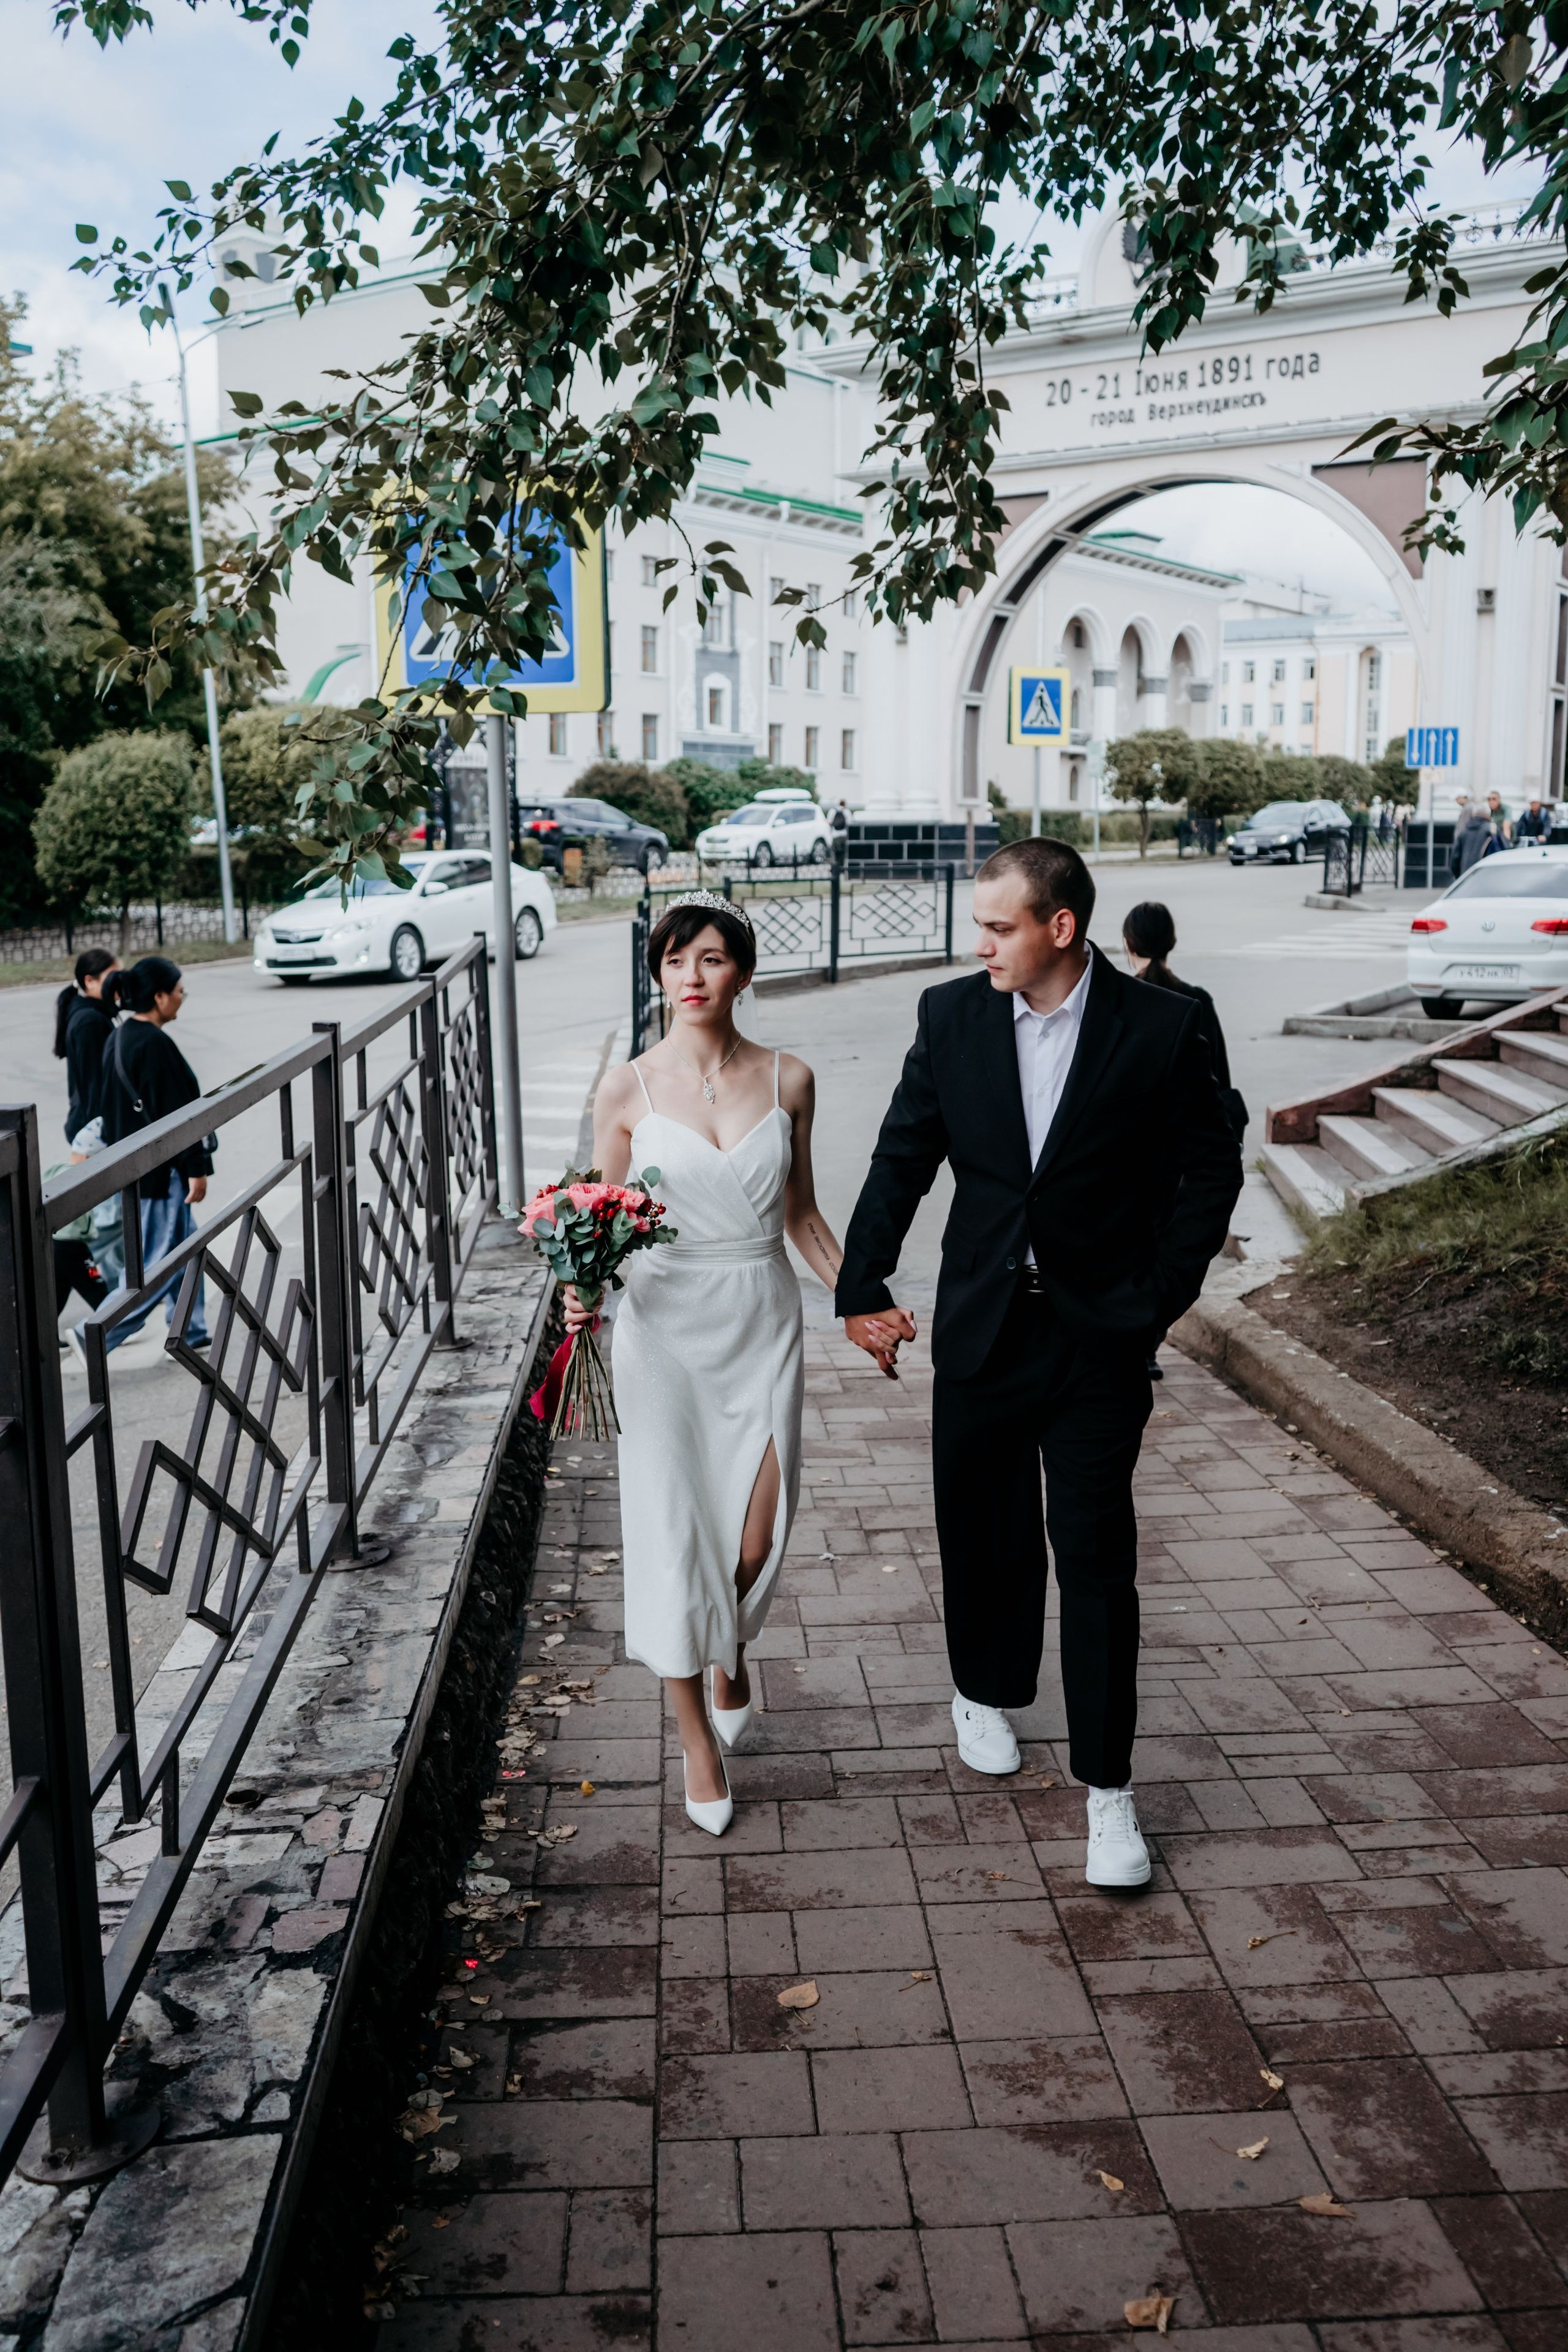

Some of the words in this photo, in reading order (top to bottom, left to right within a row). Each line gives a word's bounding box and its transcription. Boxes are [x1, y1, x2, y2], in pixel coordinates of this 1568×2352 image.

[1046, 379, 1071, 407] 20
[1097, 372, 1121, 400] 21
[1197, 354, 1254, 388] 1891
[1266, 352, 1321, 379] года
[1090, 407, 1135, 427] город
[1148, 391, 1266, 423] Верхнеудинскъ
